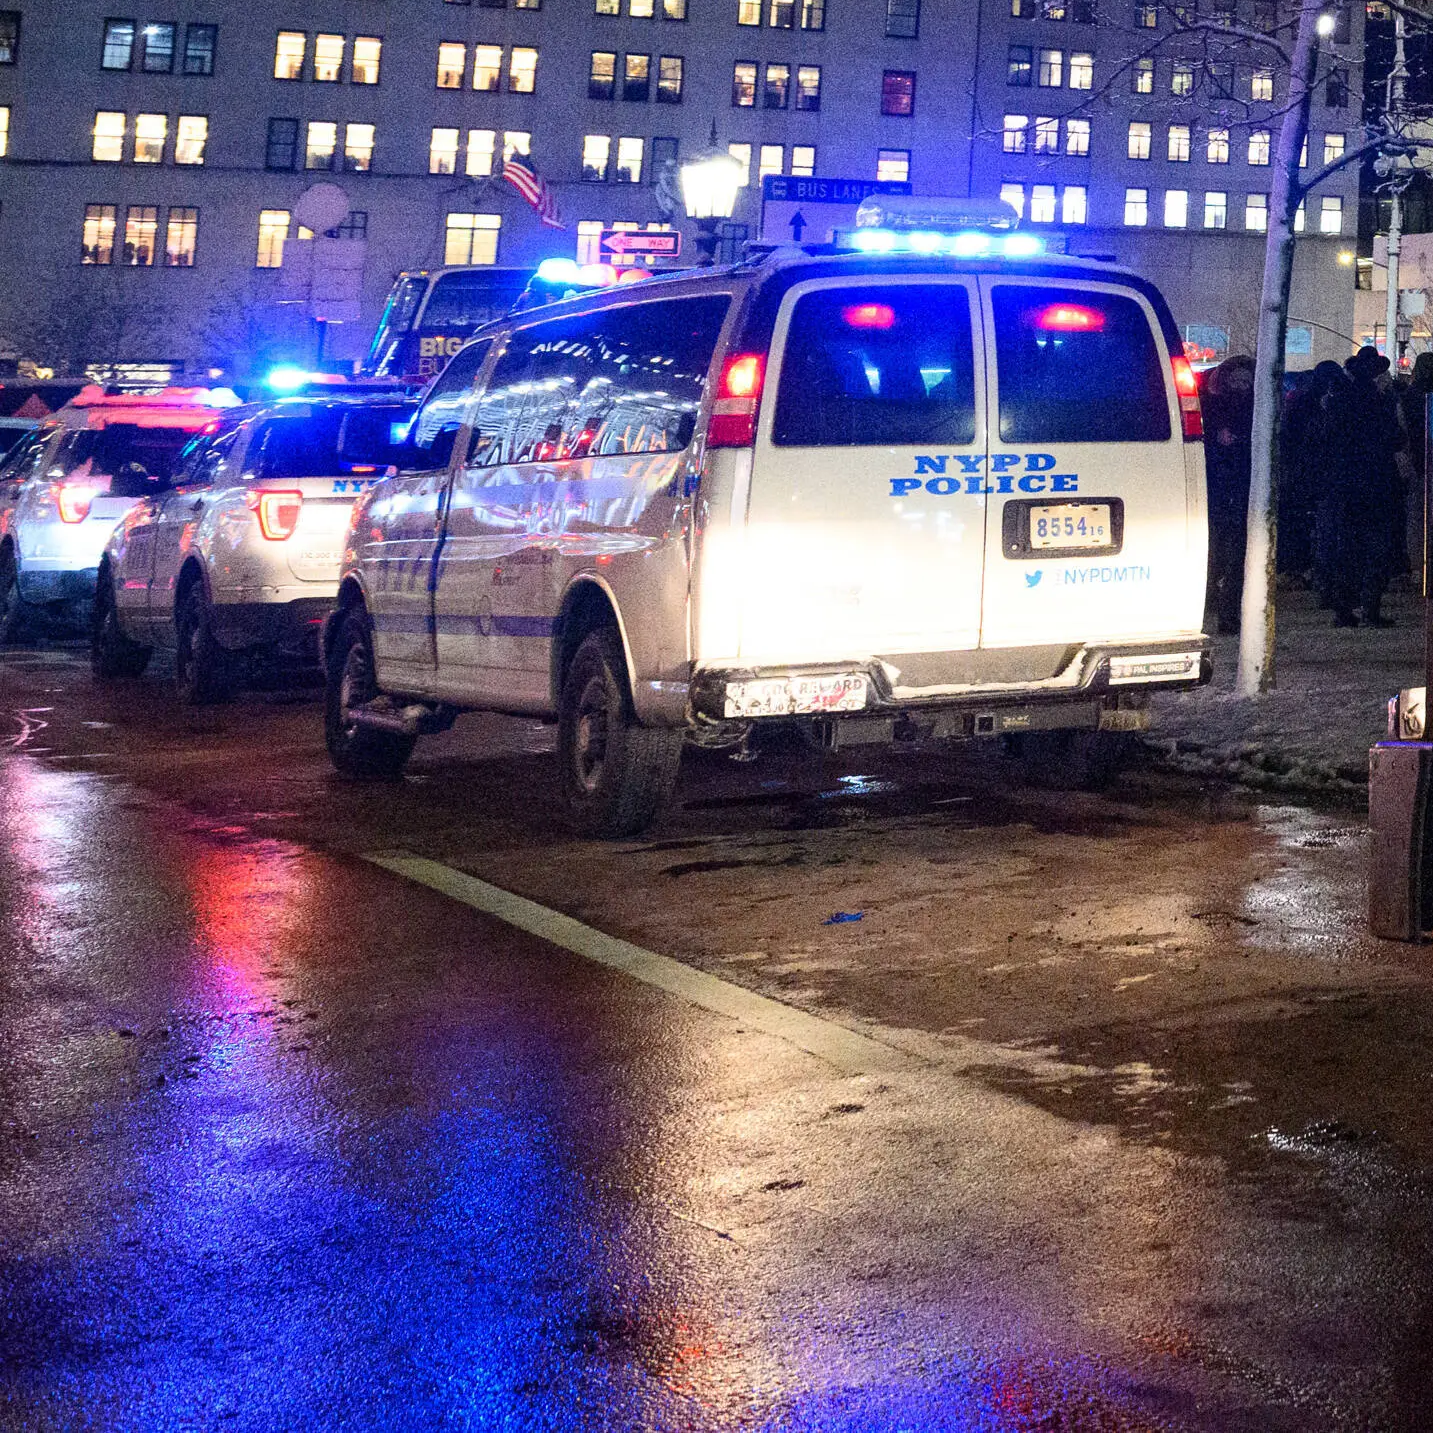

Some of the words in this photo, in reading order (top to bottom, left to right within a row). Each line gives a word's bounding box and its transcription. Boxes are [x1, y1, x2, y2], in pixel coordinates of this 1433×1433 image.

[797, 181, 827, 198] BUS
[611, 237, 633, 247] ONE
[647, 237, 671, 248] WAY
[913, 452, 1057, 475] NYPD
[889, 473, 1079, 497] POLICE
[1037, 516, 1088, 538] 8554
[1090, 525, 1104, 536] 16
